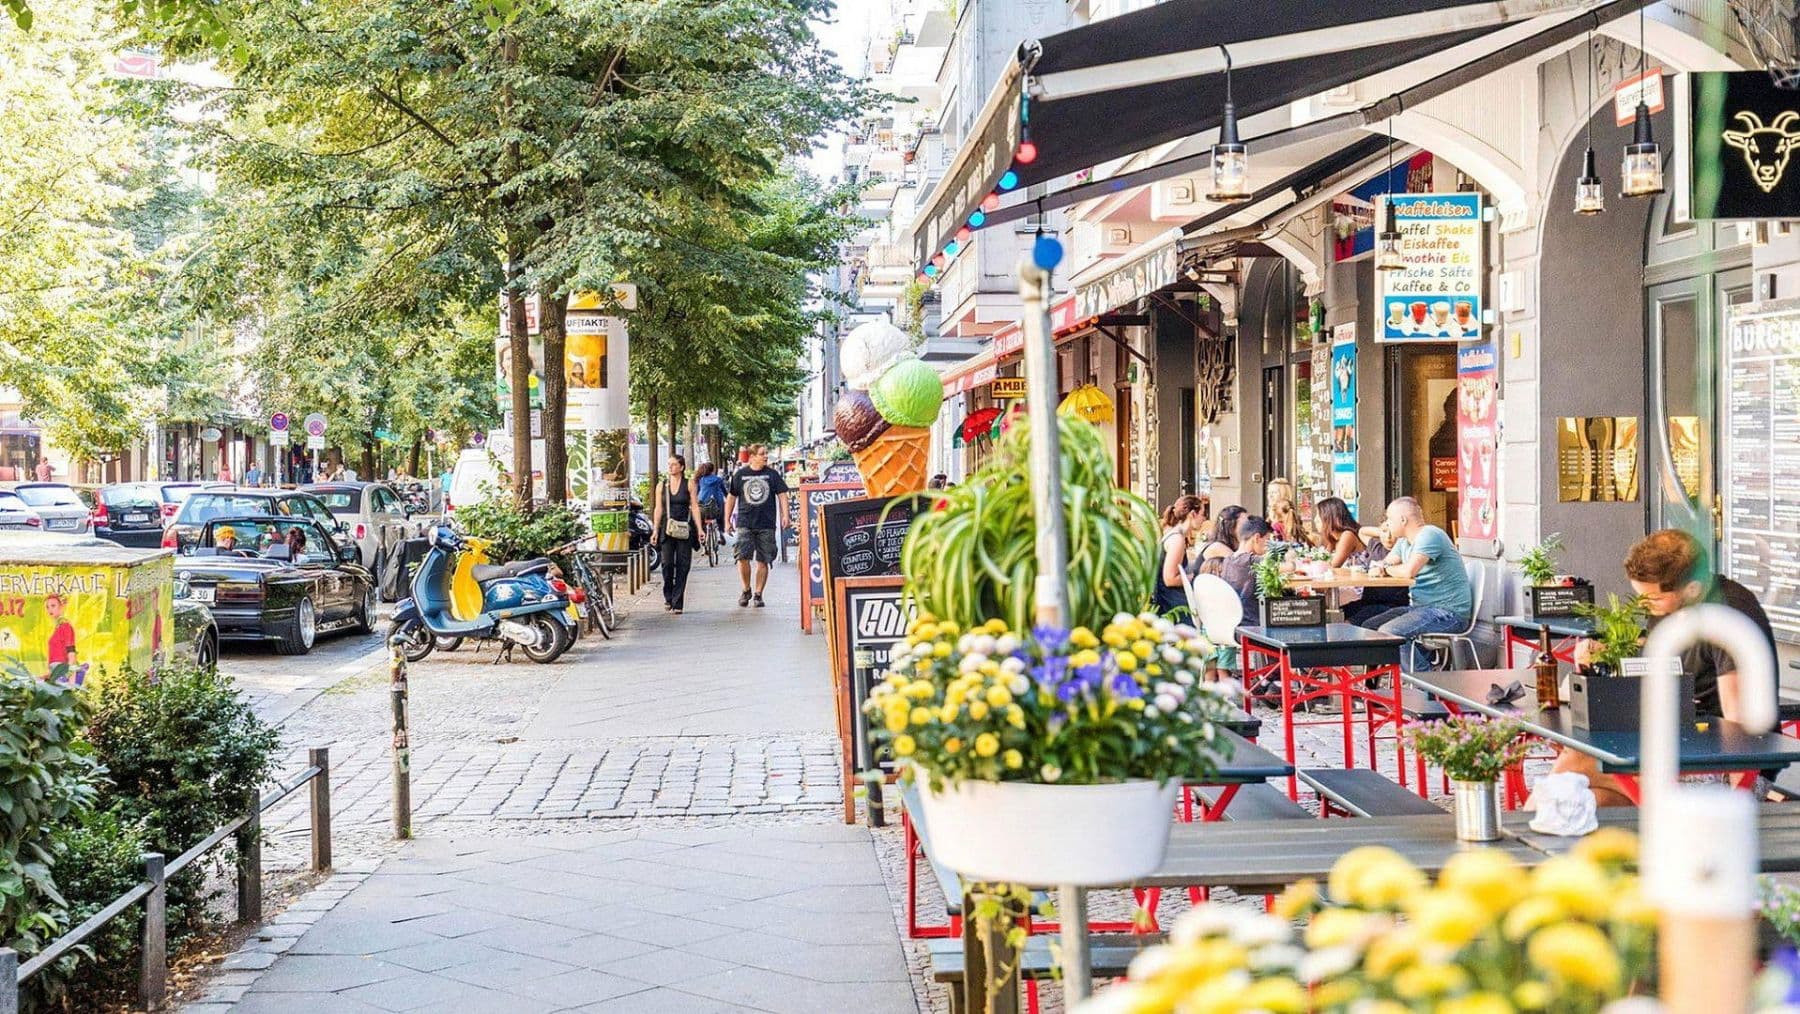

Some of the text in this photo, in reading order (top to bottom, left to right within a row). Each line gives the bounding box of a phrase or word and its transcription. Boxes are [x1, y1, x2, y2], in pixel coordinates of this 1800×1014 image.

[1399, 223, 1474, 236] affel Shake
[1403, 237, 1460, 250] Eiskaffee
[1401, 252, 1471, 264] mothie Eis
[1392, 280, 1471, 292] Kaffee & Co
